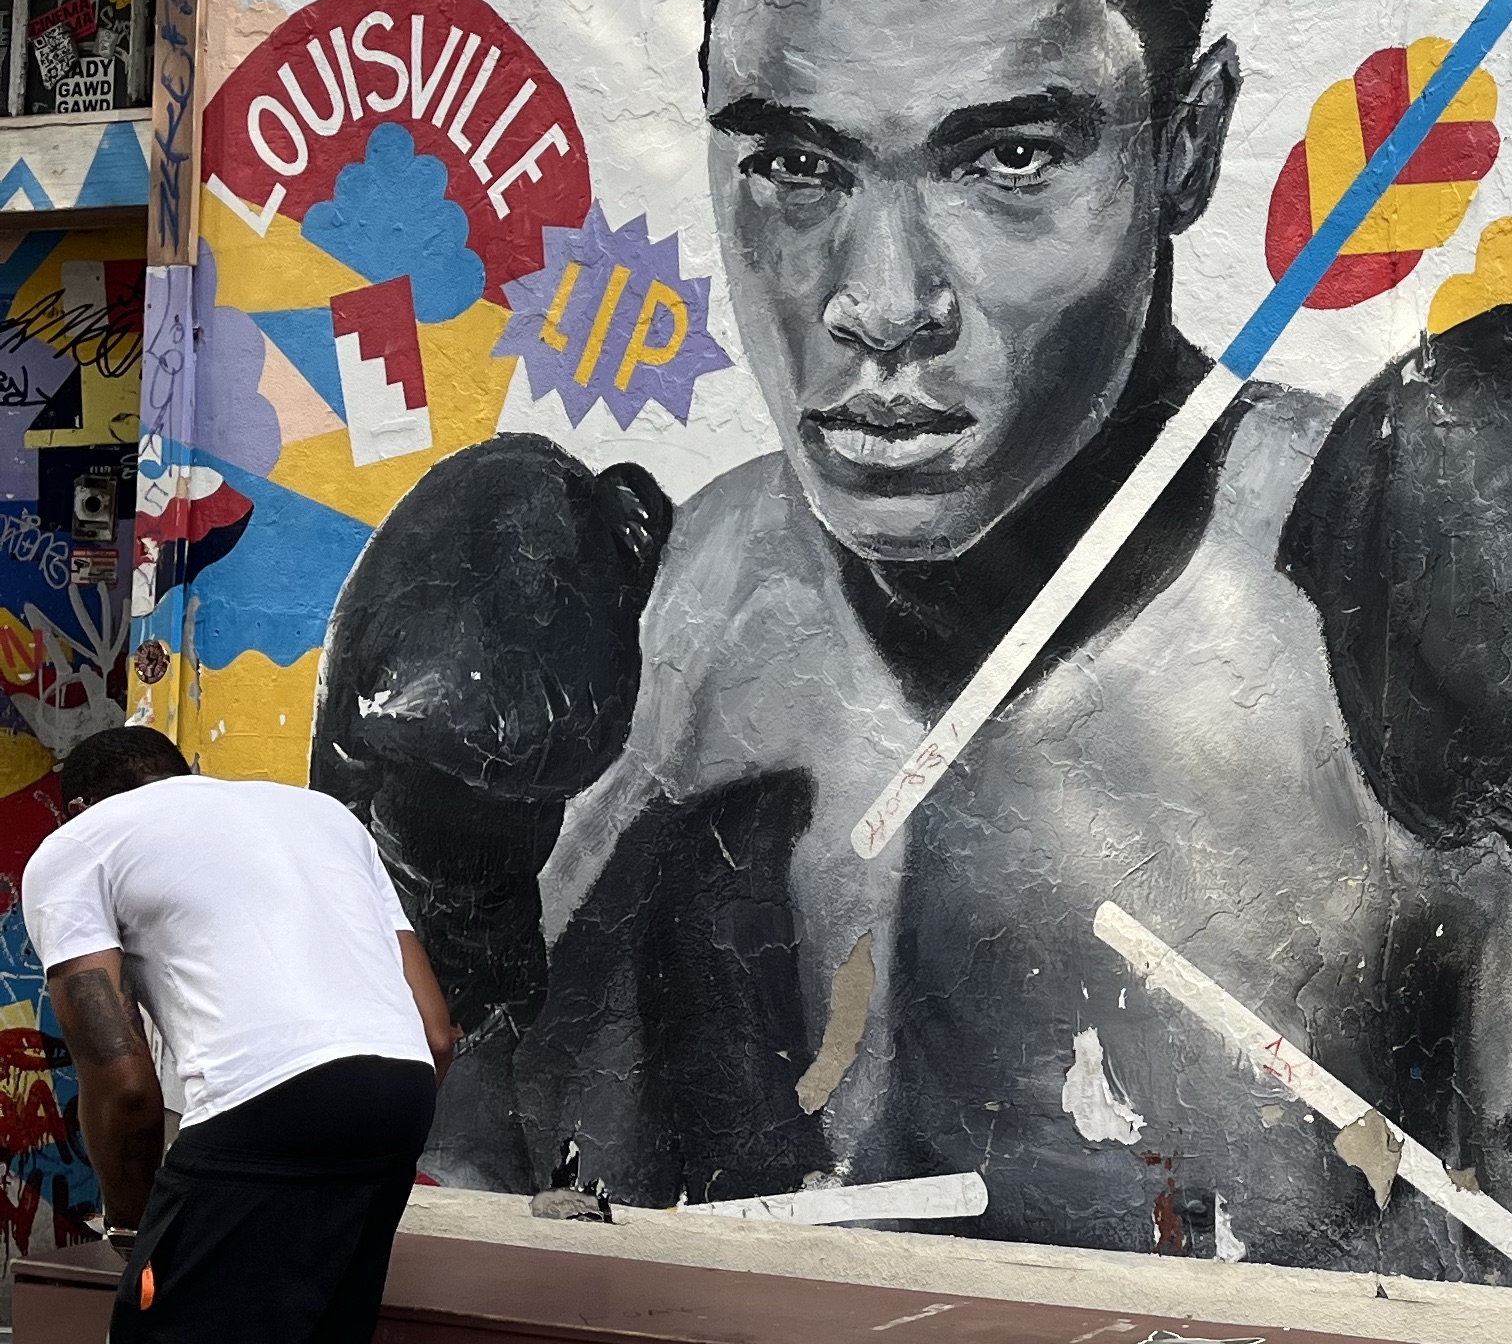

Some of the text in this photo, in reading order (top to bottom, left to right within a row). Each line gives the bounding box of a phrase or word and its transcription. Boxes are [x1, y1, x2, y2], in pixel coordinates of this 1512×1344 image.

[70, 59, 113, 79] ADY
[58, 80, 112, 98] GAWD
[57, 99, 111, 113] GAWD
[207, 11, 569, 237] LOUISVILLE
[539, 261, 688, 392] LIP
